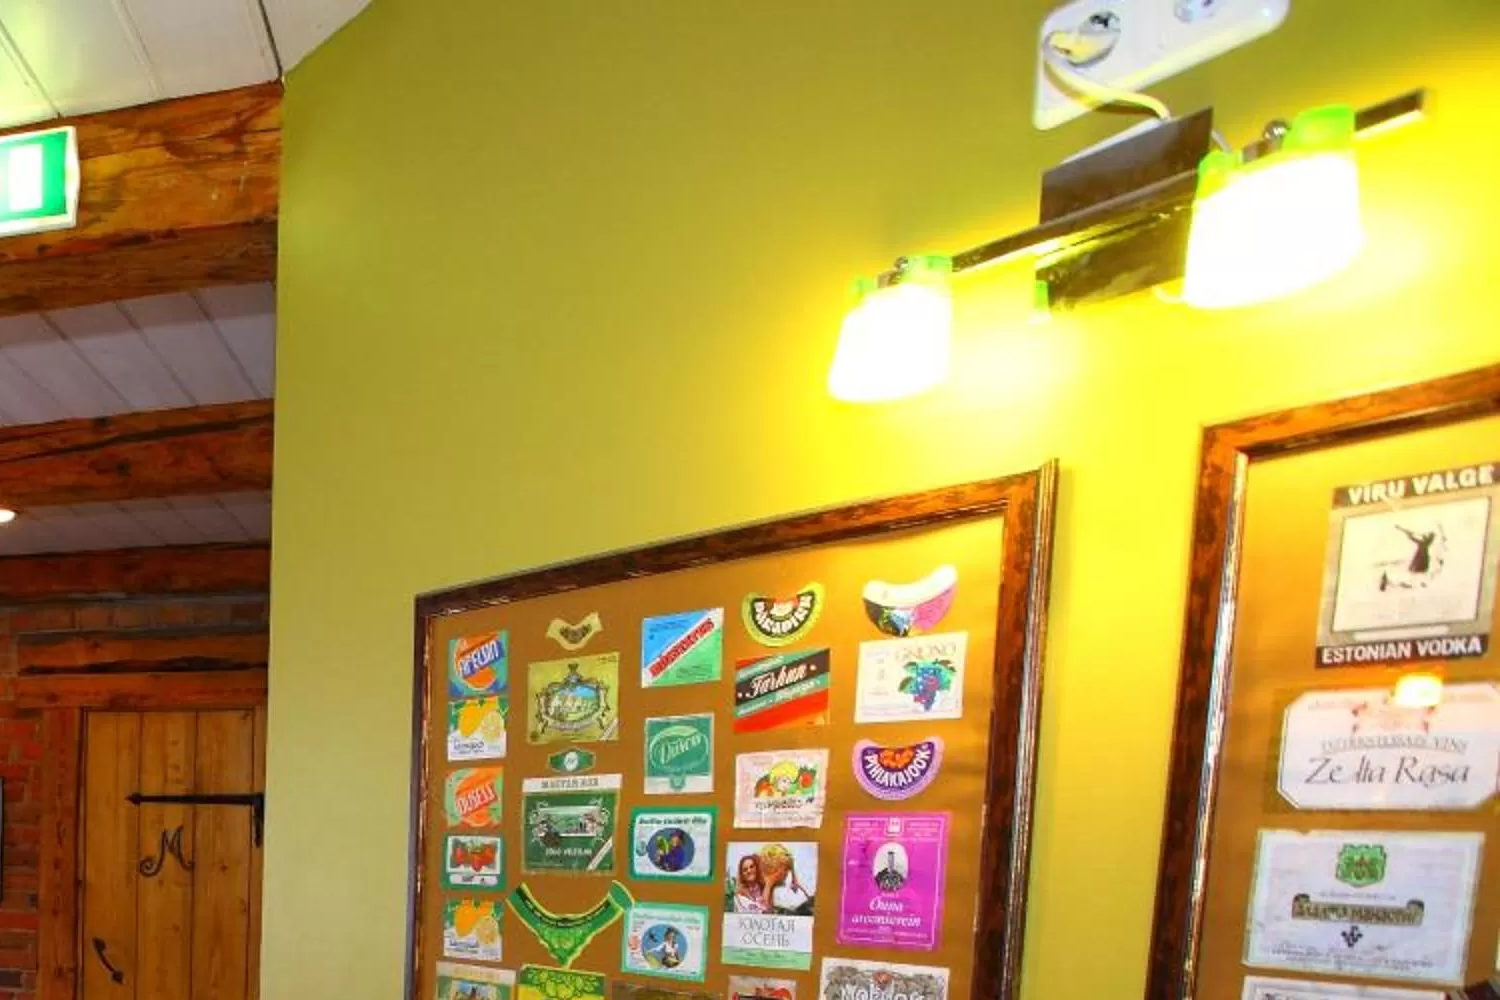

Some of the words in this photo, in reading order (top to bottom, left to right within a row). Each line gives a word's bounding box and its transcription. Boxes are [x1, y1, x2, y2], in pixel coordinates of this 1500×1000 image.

[1348, 480, 1405, 505] VIRU
[1412, 464, 1495, 496] VALGE
[1321, 640, 1413, 664] ESTONIAN
[1416, 636, 1483, 658] VODKA
